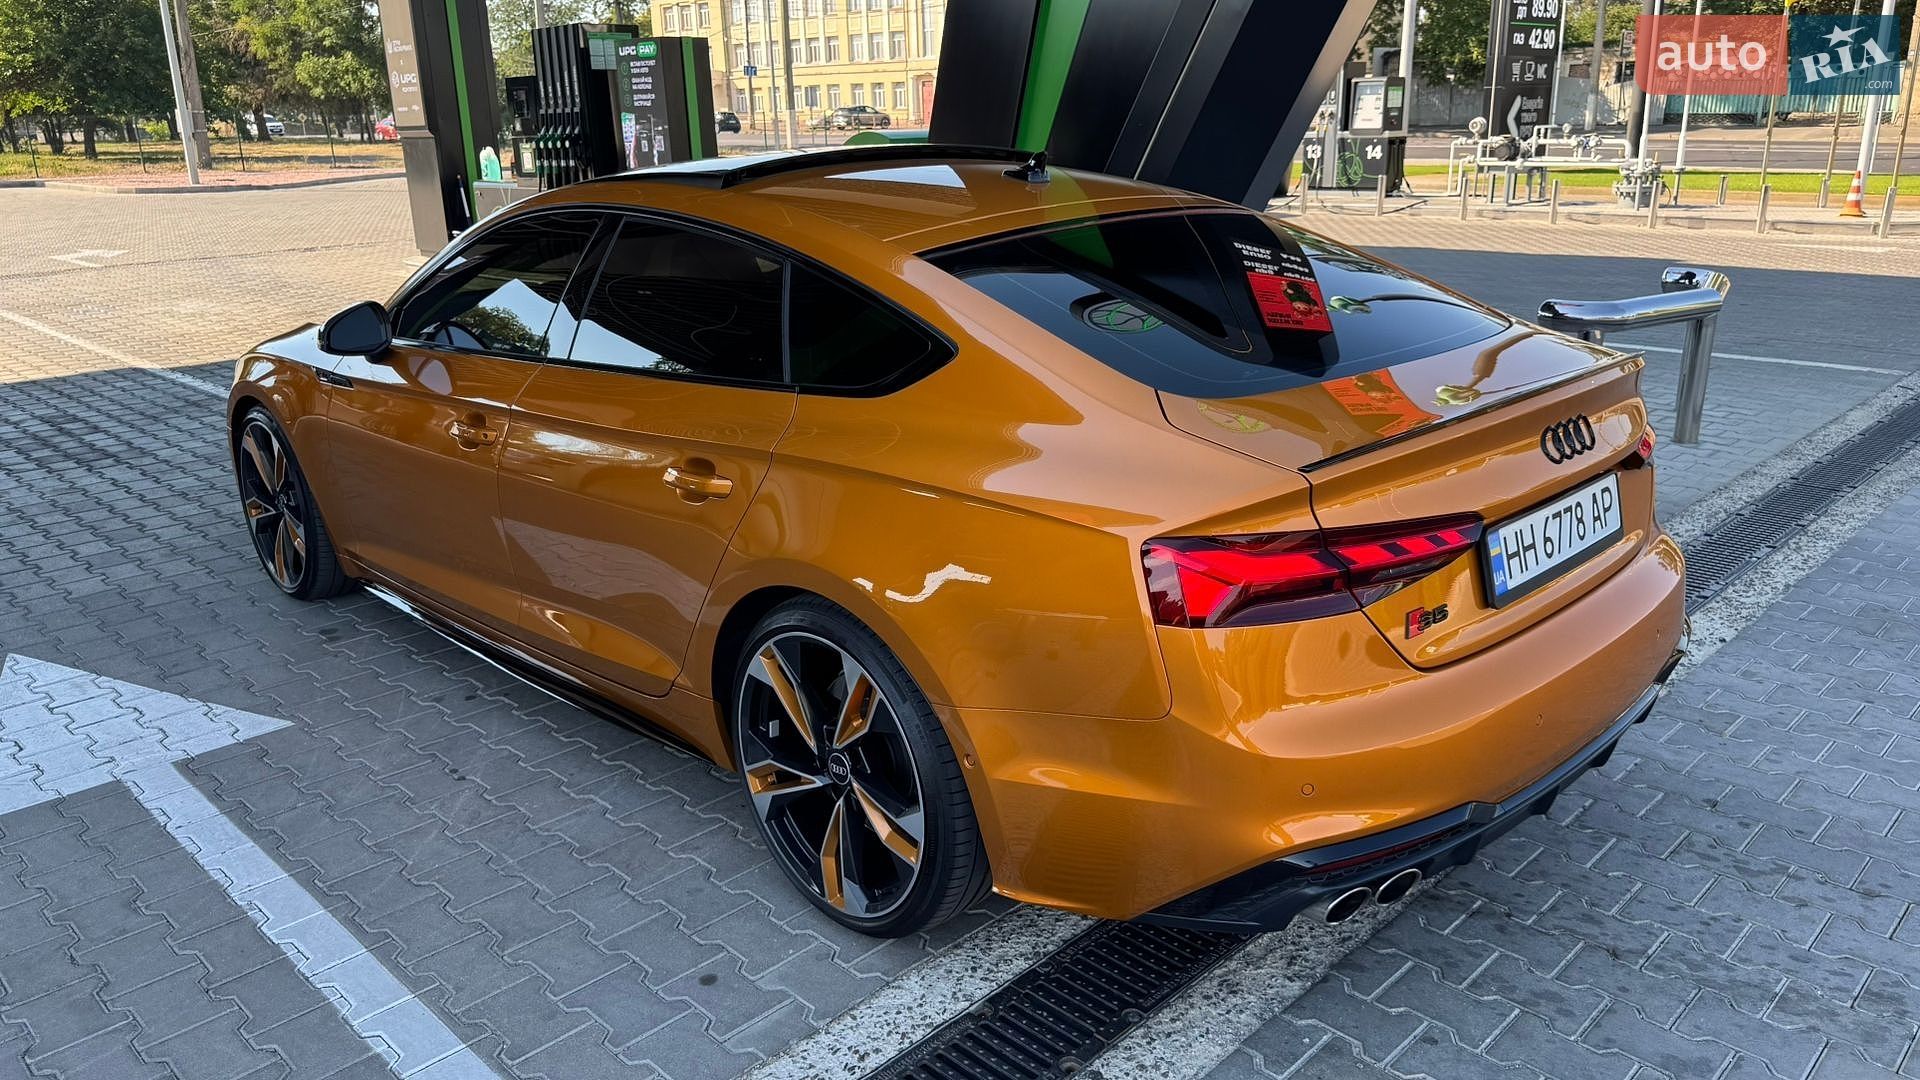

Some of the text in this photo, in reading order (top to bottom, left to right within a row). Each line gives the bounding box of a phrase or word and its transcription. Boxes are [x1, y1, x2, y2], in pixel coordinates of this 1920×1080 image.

[1531, 0, 1559, 18] 89.90
[1513, 28, 1556, 50] ГАЗ 42.90
[618, 44, 656, 57] UPG PAY
[400, 73, 417, 83] UPG
[1305, 145, 1322, 159] 13
[1365, 145, 1383, 159] 14
[1503, 486, 1613, 580] HH 6778 AP
[1493, 569, 1506, 585] UA
[1414, 603, 1449, 632] S5
